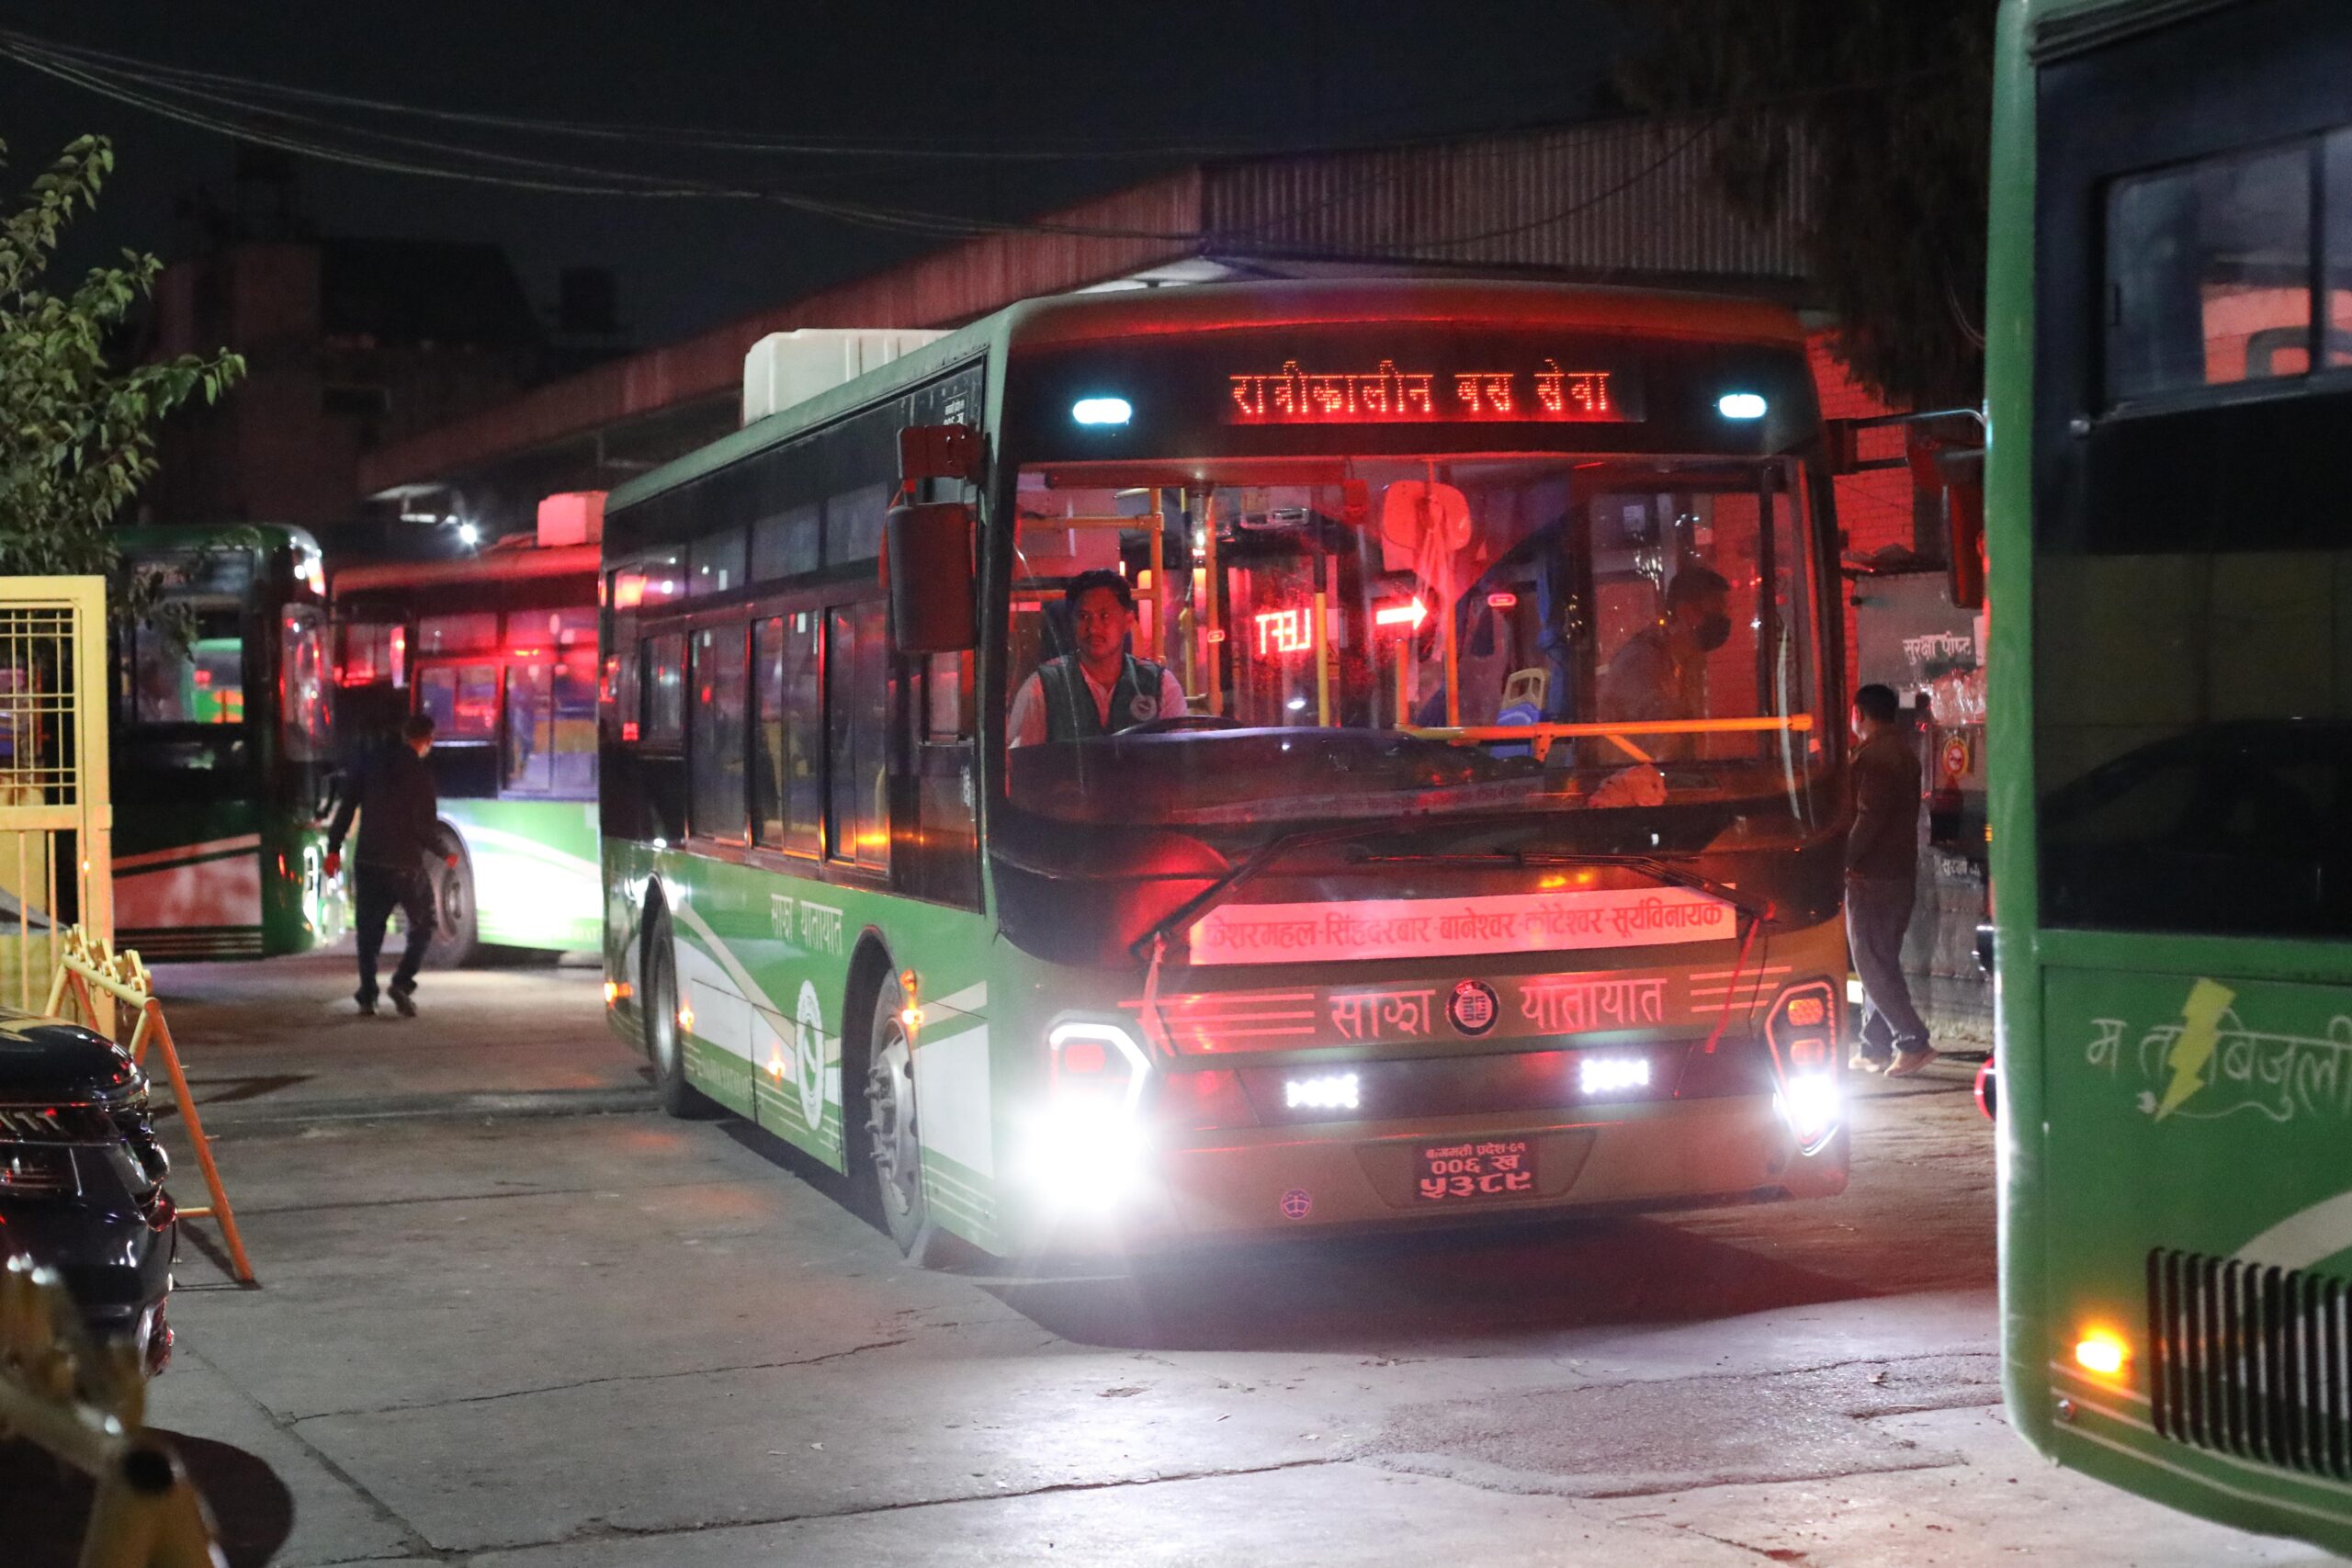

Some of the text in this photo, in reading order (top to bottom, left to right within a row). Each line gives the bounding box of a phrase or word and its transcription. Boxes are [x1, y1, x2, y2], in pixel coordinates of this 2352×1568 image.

[1454, 374, 1514, 411] बस
[1533, 358, 1610, 411] सेवा
[1519, 977, 1668, 1030] यातायात
